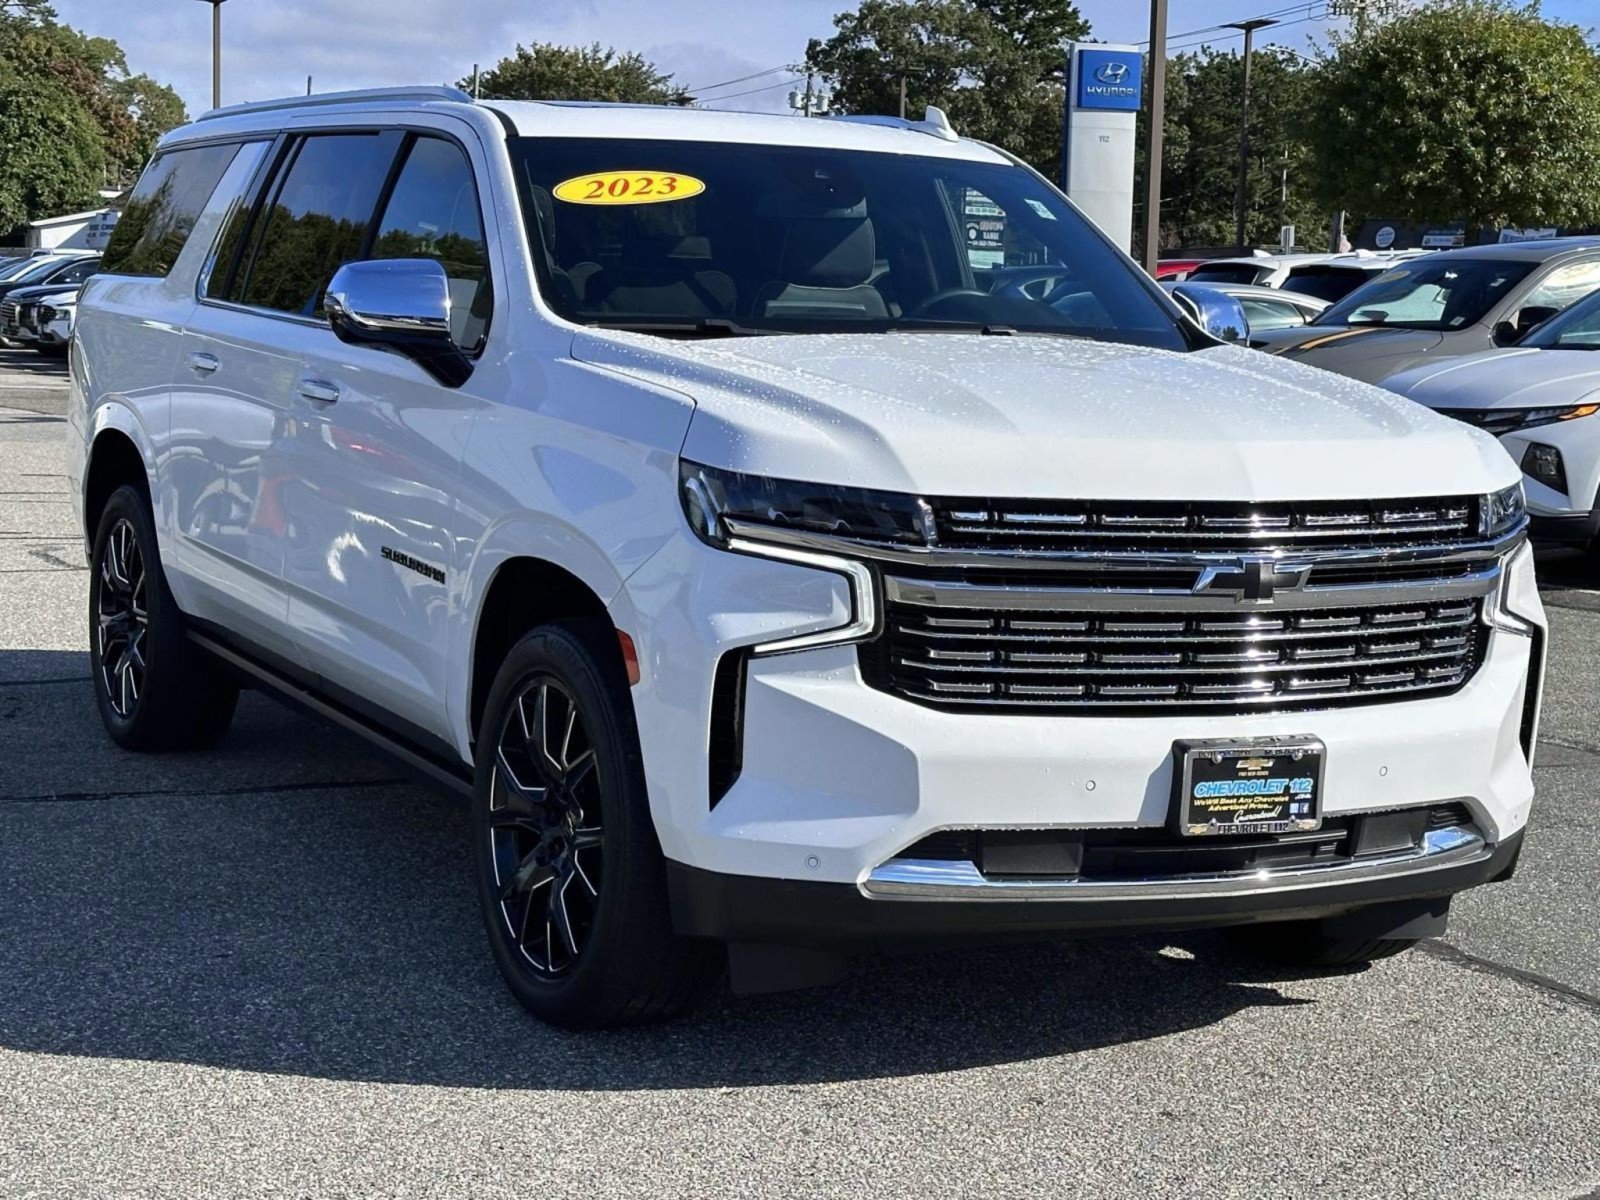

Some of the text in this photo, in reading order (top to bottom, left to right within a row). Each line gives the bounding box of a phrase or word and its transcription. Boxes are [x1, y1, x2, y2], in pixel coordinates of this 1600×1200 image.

[1087, 86, 1136, 96] HYUNDAI
[1098, 135, 1110, 143] 112
[583, 176, 678, 200] 2023
[381, 545, 446, 585] SUBURBAN
[1194, 778, 1313, 797] CHEVROLET 112
[1238, 796, 1252, 805] Any
[1253, 795, 1289, 803] Chevrolet
[1218, 822, 1289, 834] CHEVROLET 112
